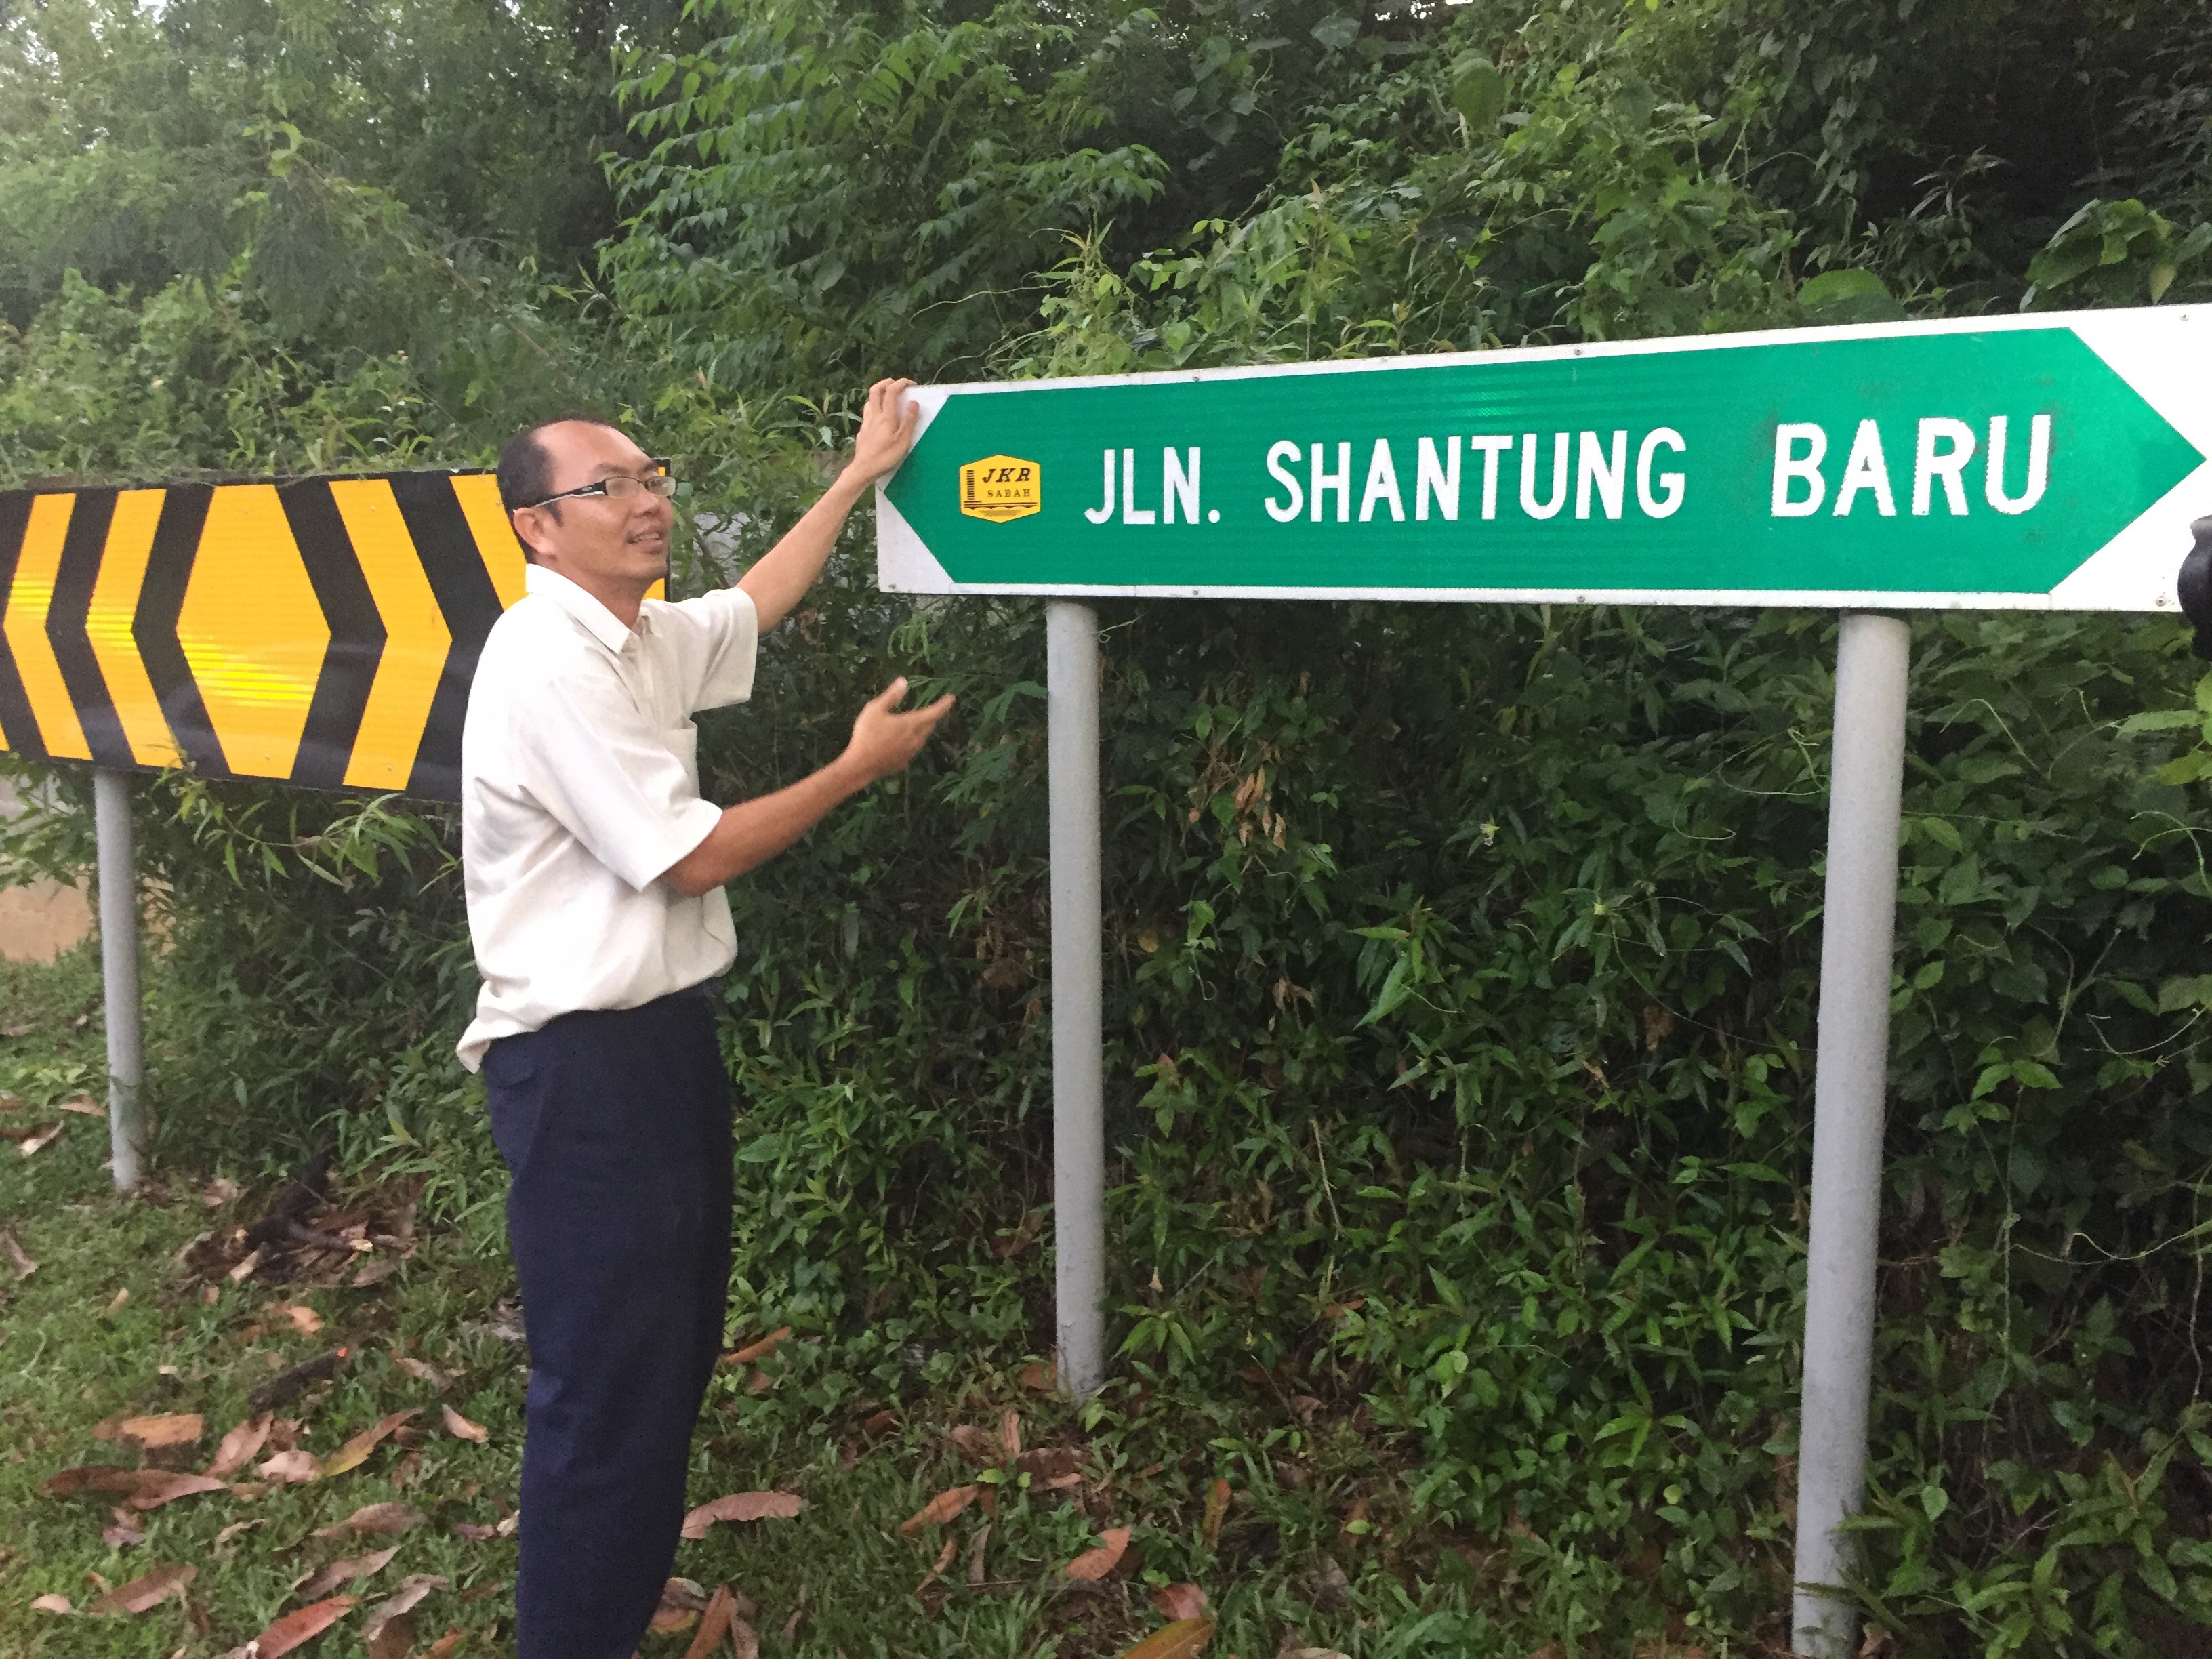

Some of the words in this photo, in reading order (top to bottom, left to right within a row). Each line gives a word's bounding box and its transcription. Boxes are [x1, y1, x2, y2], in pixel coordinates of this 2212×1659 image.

[982, 467, 1031, 483] JKR
[1084, 447, 1221, 525] JLN.
[1264, 426, 1687, 524] SHANTUNG
[1770, 414, 2052, 518] BARU
[987, 489, 1031, 498] SABAH
